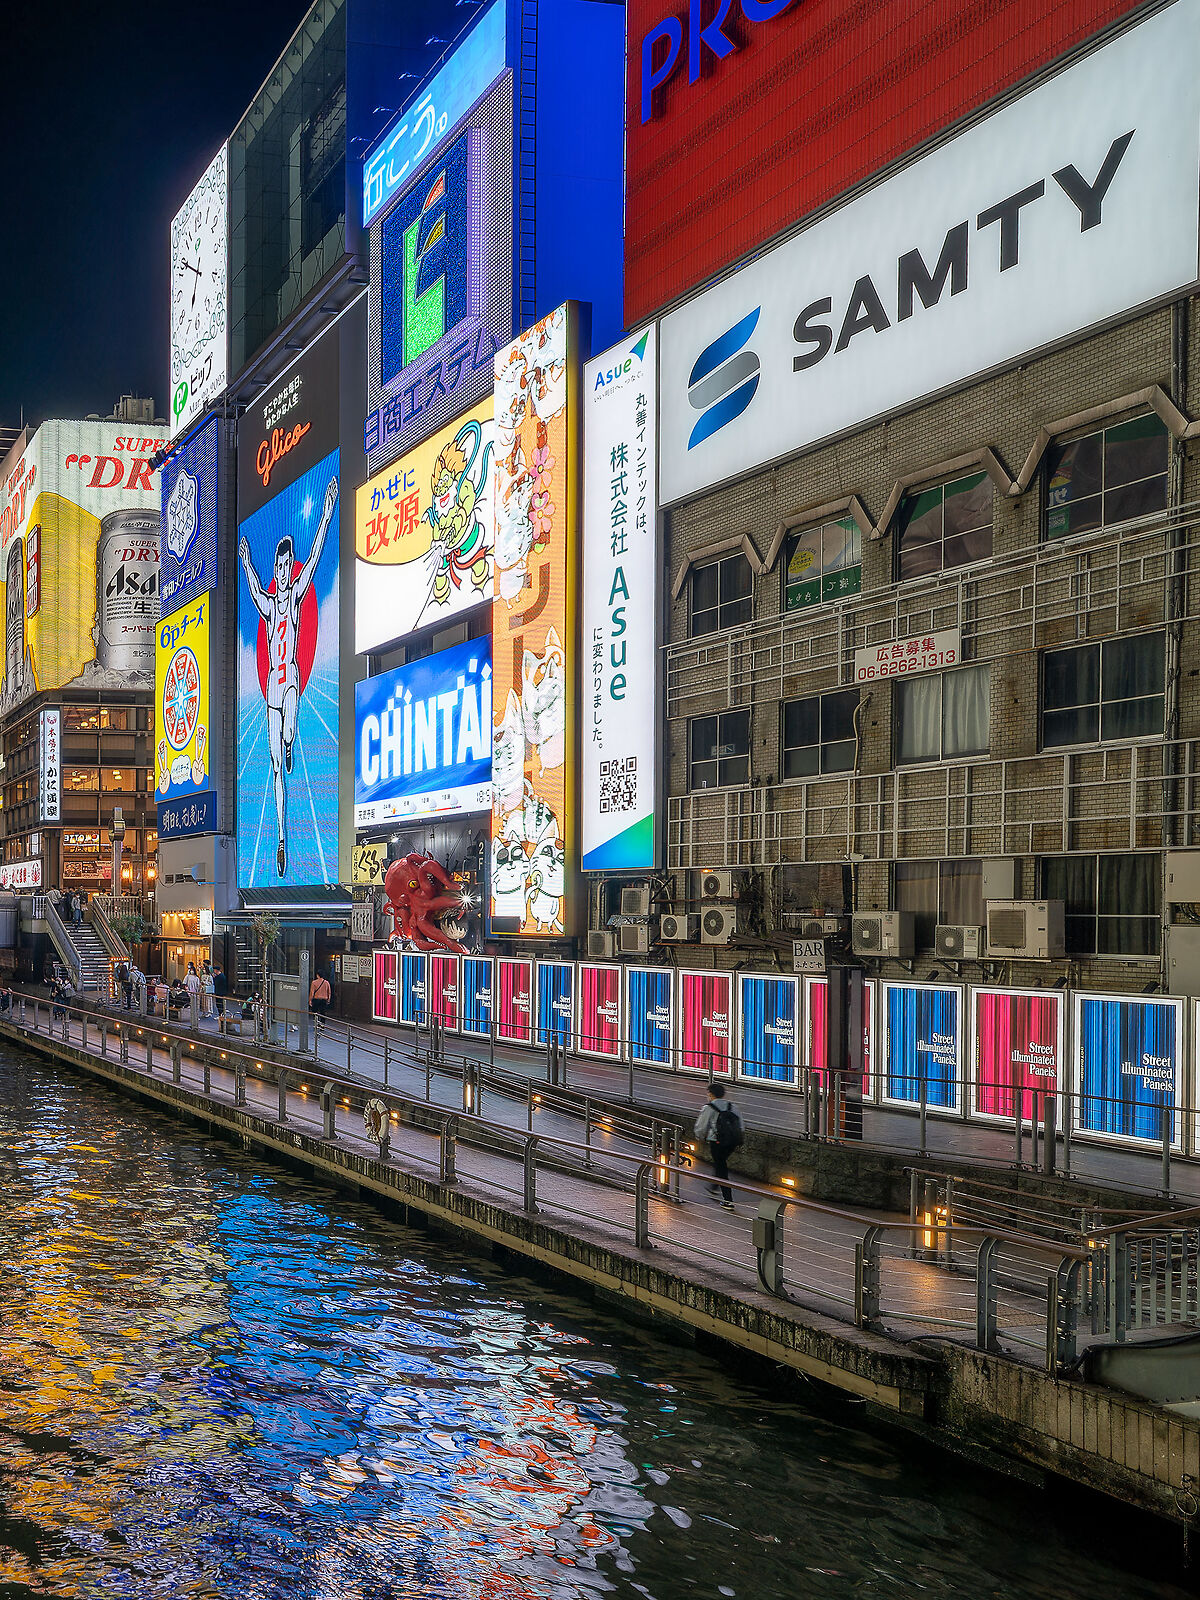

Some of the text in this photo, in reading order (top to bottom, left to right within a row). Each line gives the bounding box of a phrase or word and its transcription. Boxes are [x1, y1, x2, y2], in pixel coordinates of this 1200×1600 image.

[793, 128, 1137, 374] SAMTY
[190, 352, 214, 396] ピップ
[593, 358, 633, 392] Asue
[262, 374, 303, 419] すこやかな毎日、
[265, 391, 299, 430] ゆたかな人生
[635, 392, 648, 534] 丸善インテックは、
[370, 468, 416, 512] かぜに
[366, 488, 420, 558] 改源
[129, 540, 158, 548] SUPER
[106, 563, 161, 598] Asa
[608, 441, 630, 702] 株式会社 Asue
[134, 600, 153, 615] 生
[277, 614, 288, 685] グリコ
[858, 649, 956, 681] 06-6262-1313
[876, 636, 936, 662] 広告募集
[591, 626, 604, 751] に変わりました。
[46, 766, 57, 817] かに道楽
[793, 942, 824, 957] BAR
[795, 960, 823, 969] ふたごや
[932, 1032, 954, 1045] Street
[1029, 1042, 1053, 1056] Street
[1142, 1053, 1171, 1068] Street
